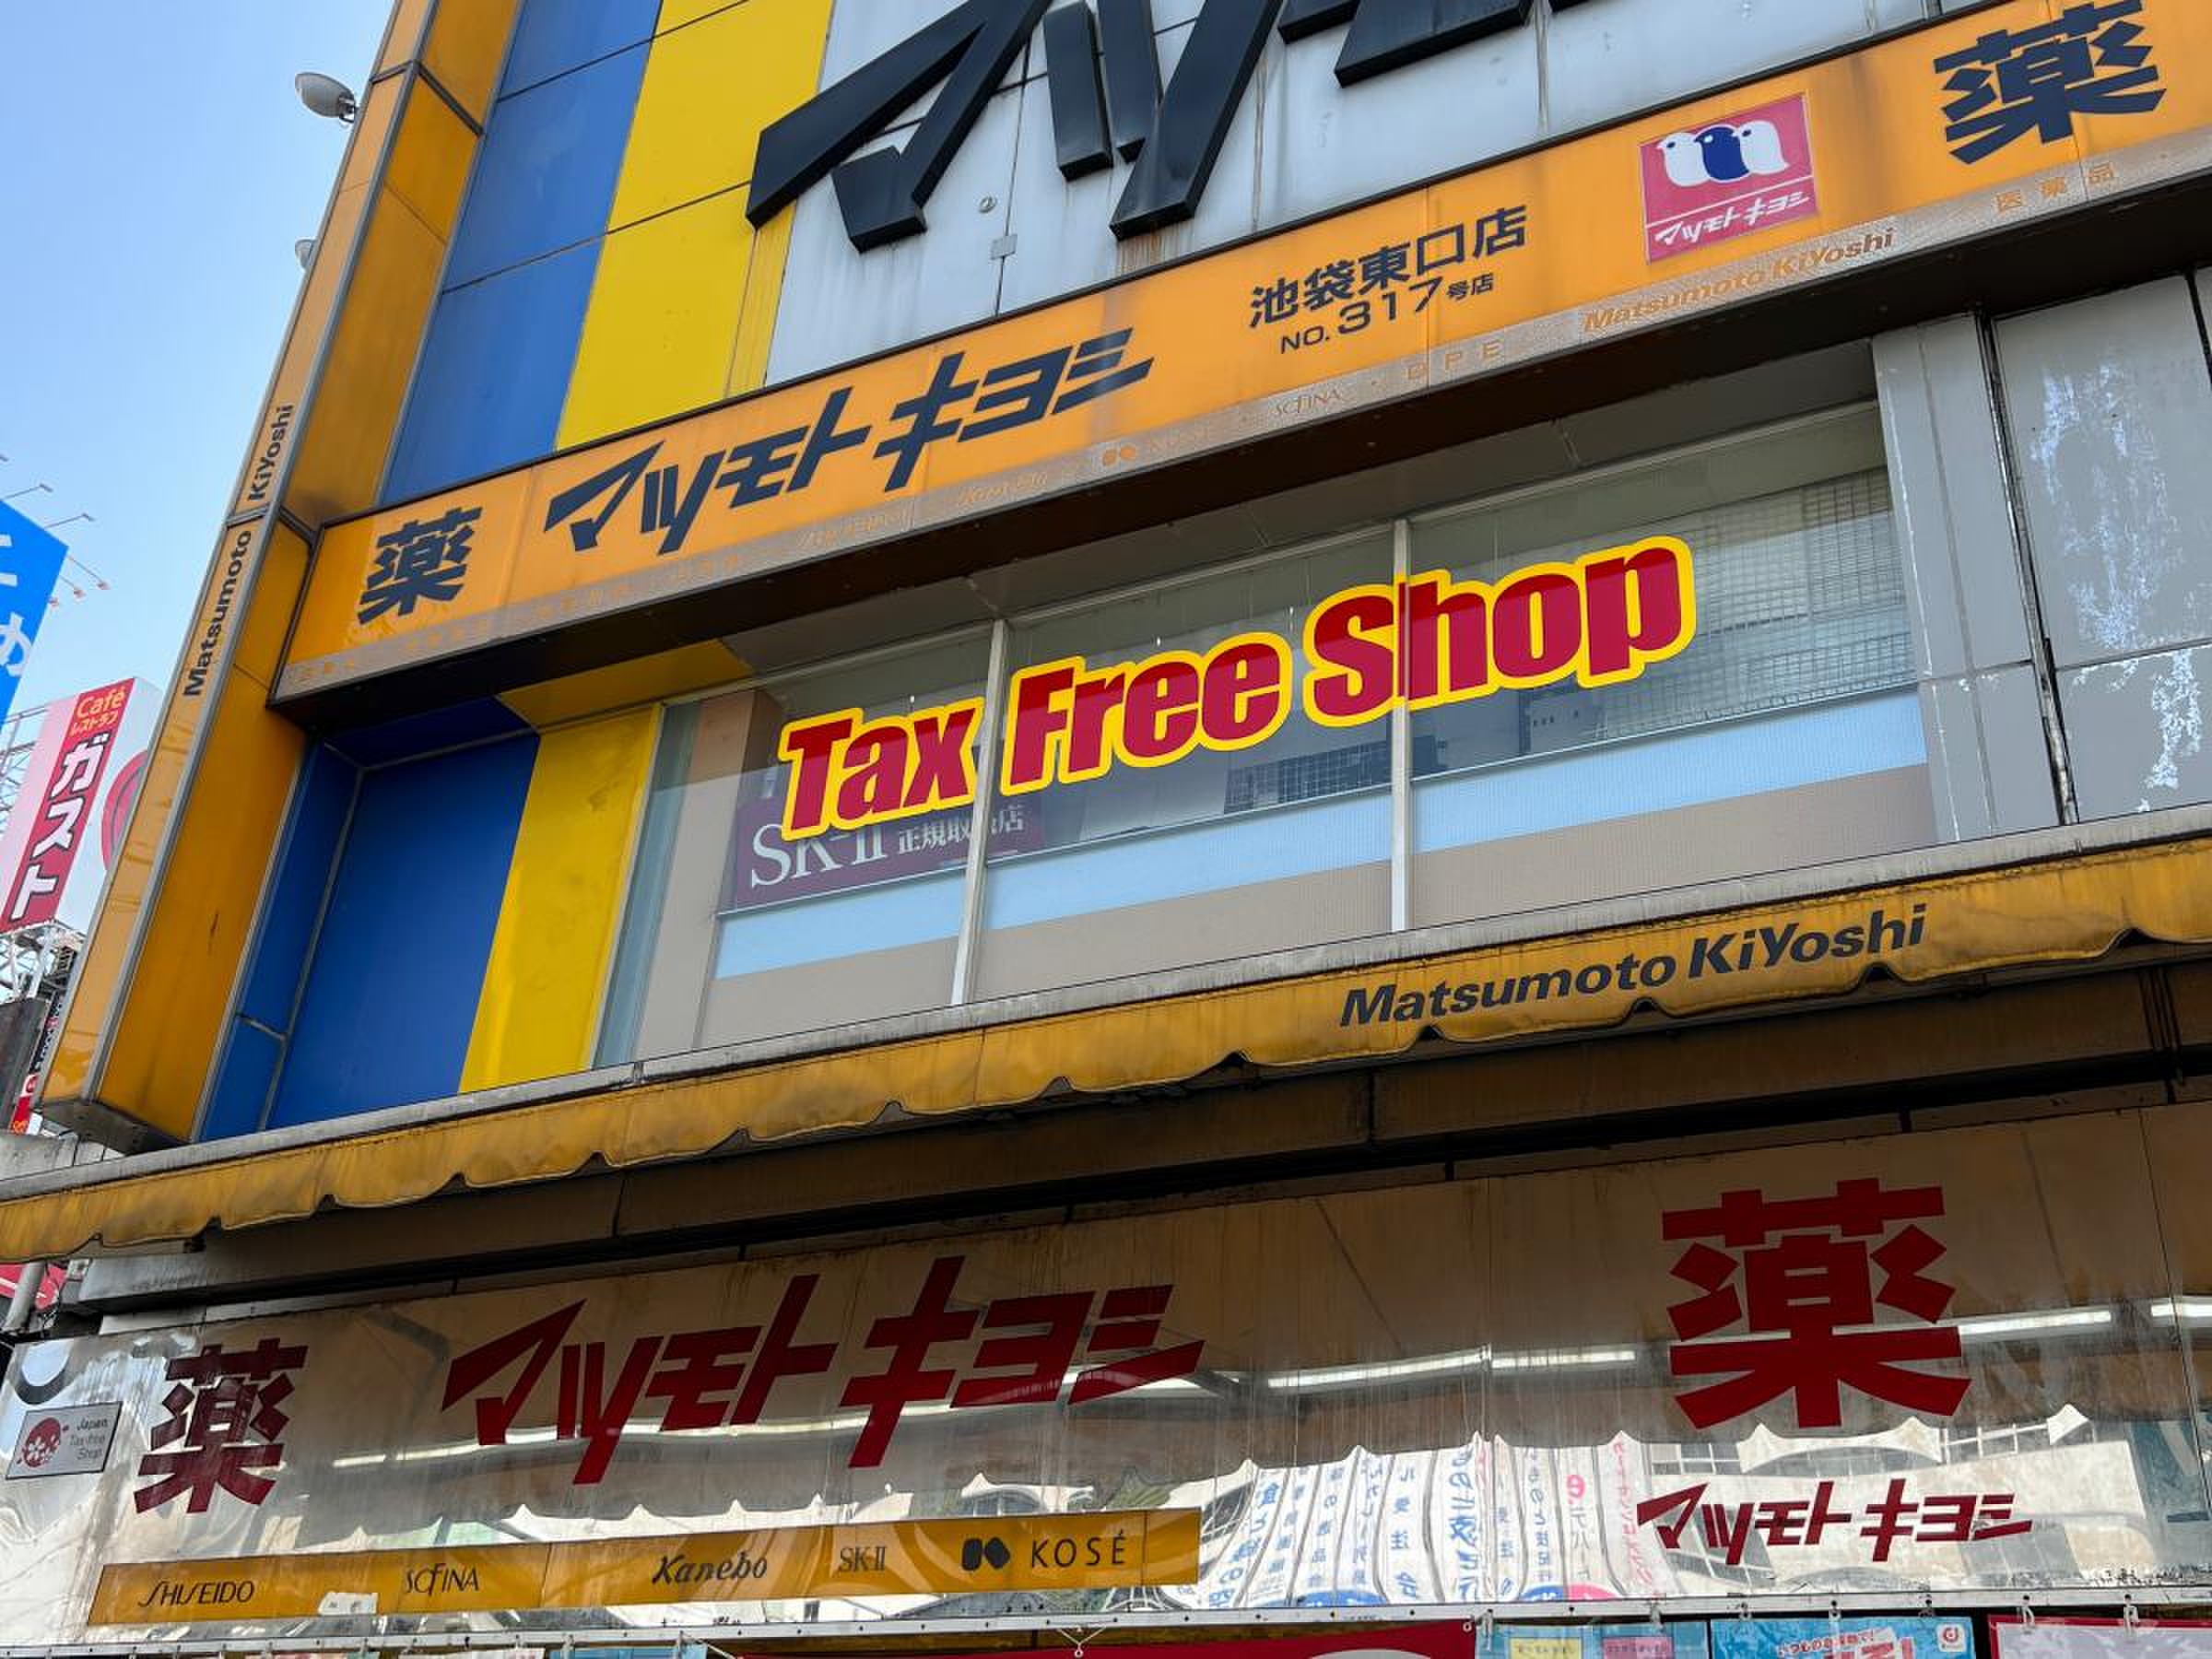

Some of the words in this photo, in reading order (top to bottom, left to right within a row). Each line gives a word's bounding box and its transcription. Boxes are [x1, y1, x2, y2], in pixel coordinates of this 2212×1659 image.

[1934, 0, 2167, 164] 薬
[1250, 205, 1527, 327] 池袋東口店
[1654, 191, 1809, 245] マツモトキヨシ
[545, 327, 1153, 554] マツモトキヨシ
[183, 530, 252, 697] Matsumoto
[248, 404, 293, 501] KiYoshi
[358, 505, 483, 625] 薬
[781, 700, 982, 840] Tax
[1000, 632, 1290, 797] Free
[1303, 535, 1694, 728] Shop
[8, 733, 110, 922] ガスト
[898, 804, 1026, 855] 正規取店
[1338, 951, 1677, 1028] Matsumoto
[1688, 902, 1927, 978] KiYoshi
[442, 1254, 1205, 1485] マツモトキヨシ
[1663, 1178, 1971, 1430] 薬
[135, 1336, 307, 1514] 薬
[137, 1579, 254, 1608] SHISEIDO
[403, 1563, 479, 1595] SOFINA
[652, 1550, 768, 1585] Kanebo
[1031, 1529, 1126, 1568] KOSÉ
[1636, 1478, 2033, 1565] マツモトキヨシ
